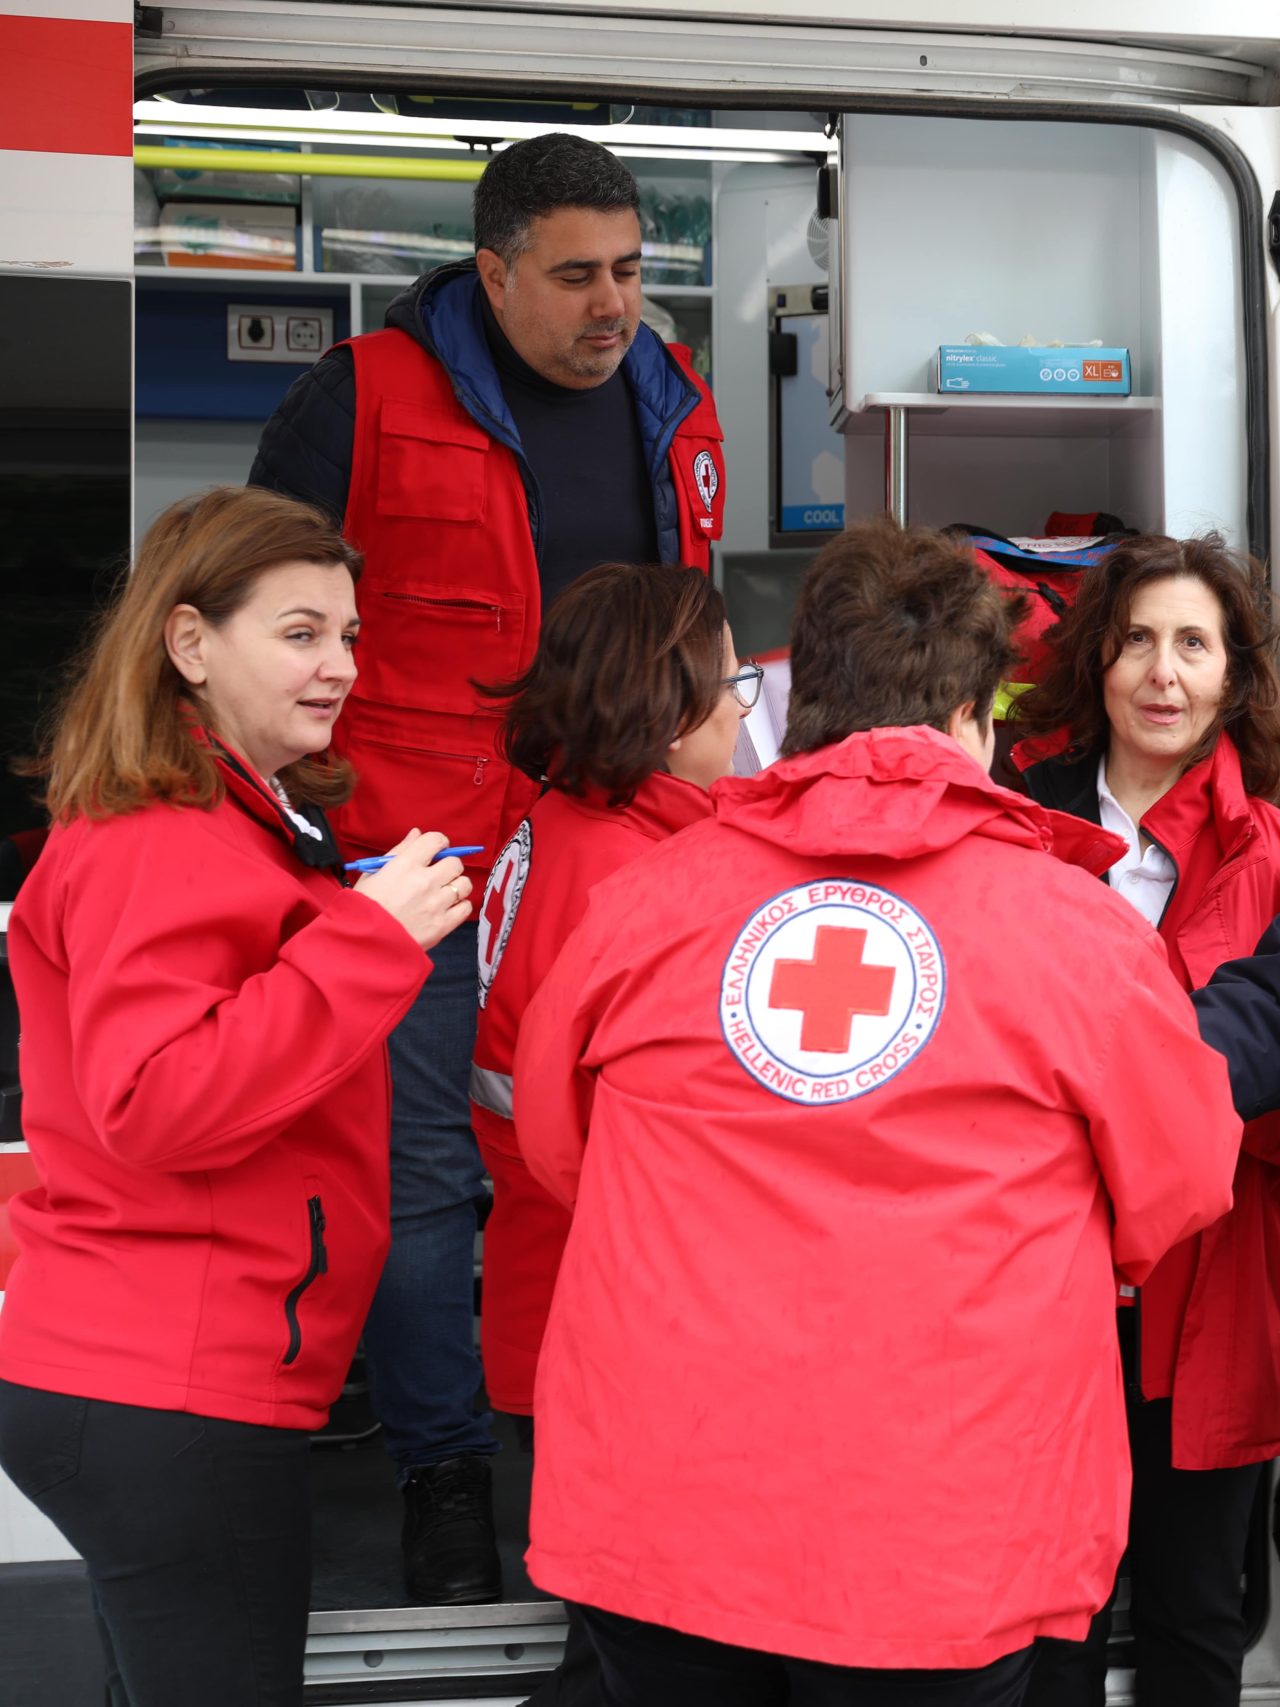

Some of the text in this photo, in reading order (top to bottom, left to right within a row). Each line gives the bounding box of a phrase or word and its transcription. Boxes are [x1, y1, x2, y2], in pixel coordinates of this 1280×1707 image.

[1084, 365, 1099, 377] XL
[803, 510, 840, 524] COOL
[726, 885, 939, 1018] ΕΛΛΗΝΙΚΟΣ ΕΡΥΘΡΟΣ ΣΤΑΥΡΟΣ
[728, 1020, 919, 1099] HELLENIC RED CROSS
